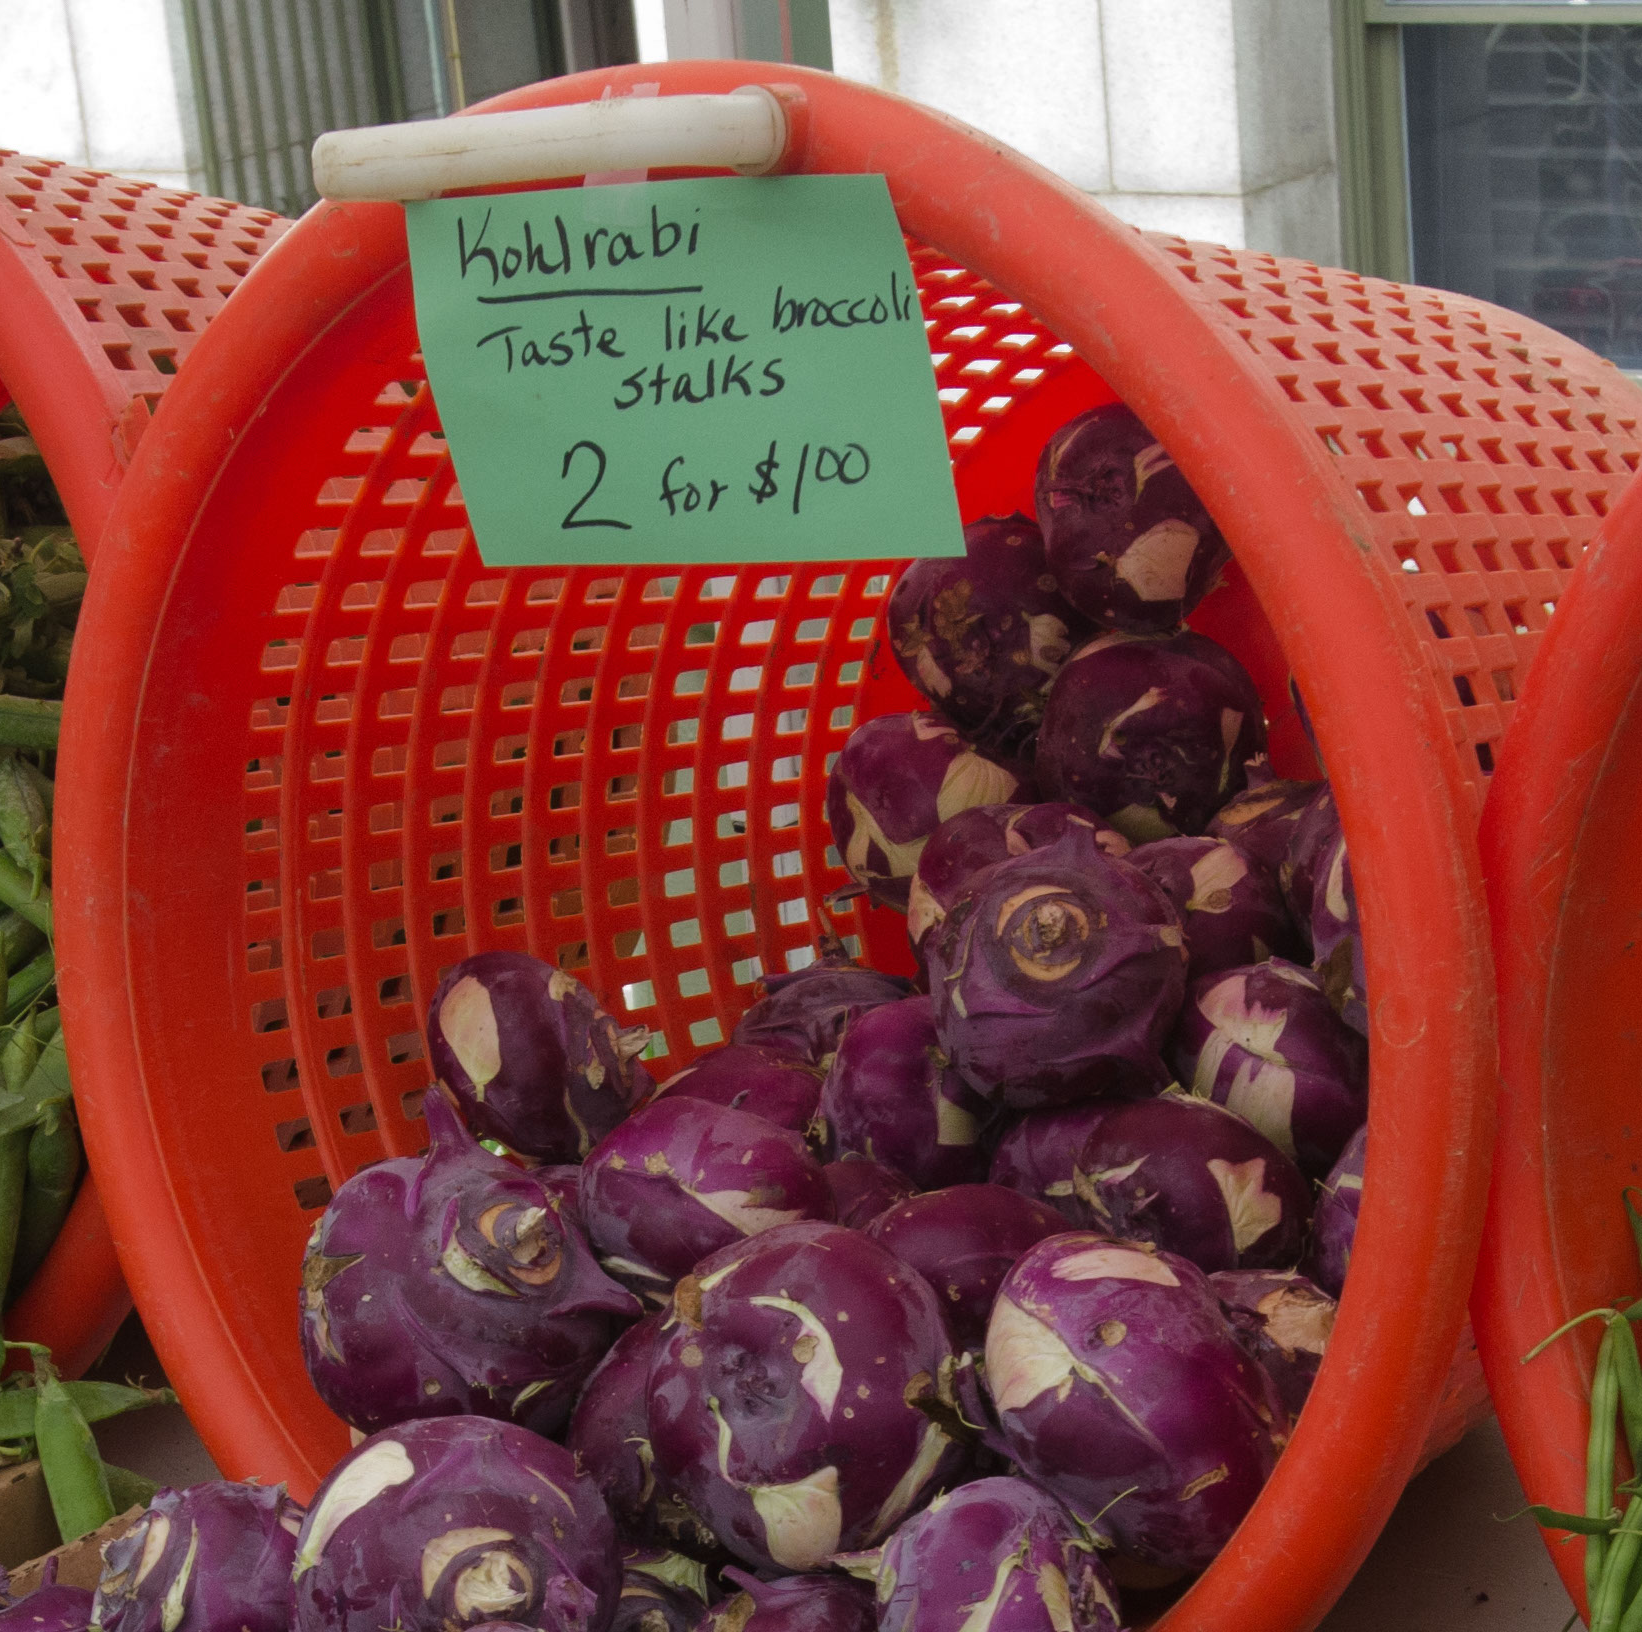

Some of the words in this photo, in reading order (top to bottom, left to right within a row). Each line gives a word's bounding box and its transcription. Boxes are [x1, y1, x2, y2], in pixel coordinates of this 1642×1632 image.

[457, 205, 701, 286] Kohlrabi
[476, 310, 626, 372] Taste
[665, 304, 748, 351] like
[772, 271, 911, 333] broccoli
[561, 440, 632, 529] 2
[660, 456, 728, 516] for
